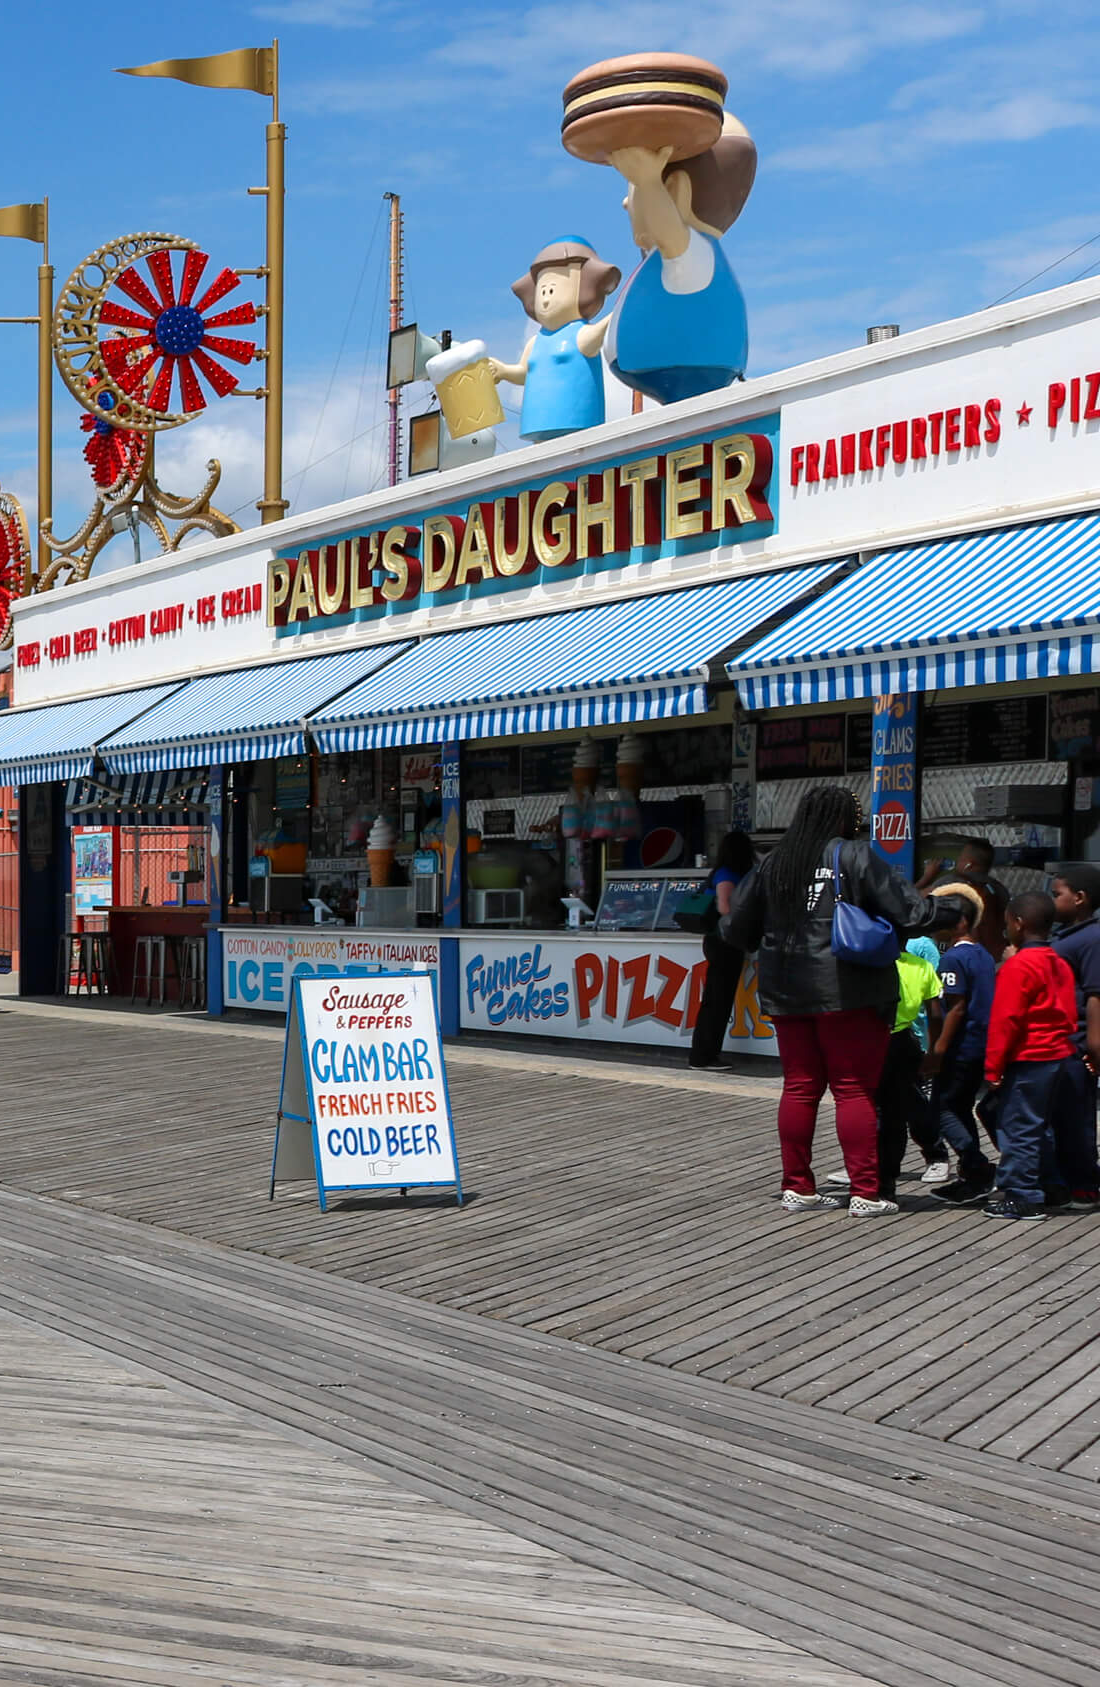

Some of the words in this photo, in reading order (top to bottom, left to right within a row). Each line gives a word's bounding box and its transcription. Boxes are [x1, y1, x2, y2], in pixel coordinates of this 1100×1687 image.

[790, 397, 1001, 487] FRANKFURTERS
[267, 525, 422, 628] PAUL'S
[423, 432, 774, 593] DAUGHTER
[17, 641, 41, 668] FRIES
[49, 634, 71, 660] COLD
[73, 627, 98, 655] BEER
[108, 614, 146, 647] COTTON
[150, 603, 185, 636] CANDY
[196, 595, 216, 625] ICE
[221, 583, 262, 619] CREAM
[874, 727, 914, 756] CLAMS
[443, 762, 459, 777] ICE
[873, 763, 914, 793] FRIES
[872, 813, 913, 840] PIZZA
[227, 938, 259, 955] COTTON
[259, 940, 287, 957] CANDY
[346, 942, 377, 961] TAFFY
[382, 944, 418, 962] ITALIAN
[419, 945, 438, 964] ICES
[228, 959, 285, 1003] ICE
[322, 985, 410, 1015] Sausage
[336, 1015, 346, 1030] &
[348, 1015, 413, 1030] PEPPERS
[311, 1038, 381, 1083] CLAM
[382, 1037, 434, 1082] BAR
[317, 1093, 383, 1118] FRENCH
[387, 1091, 438, 1114] FRIES
[327, 1127, 382, 1157] COLD
[386, 1124, 442, 1158] BEER
